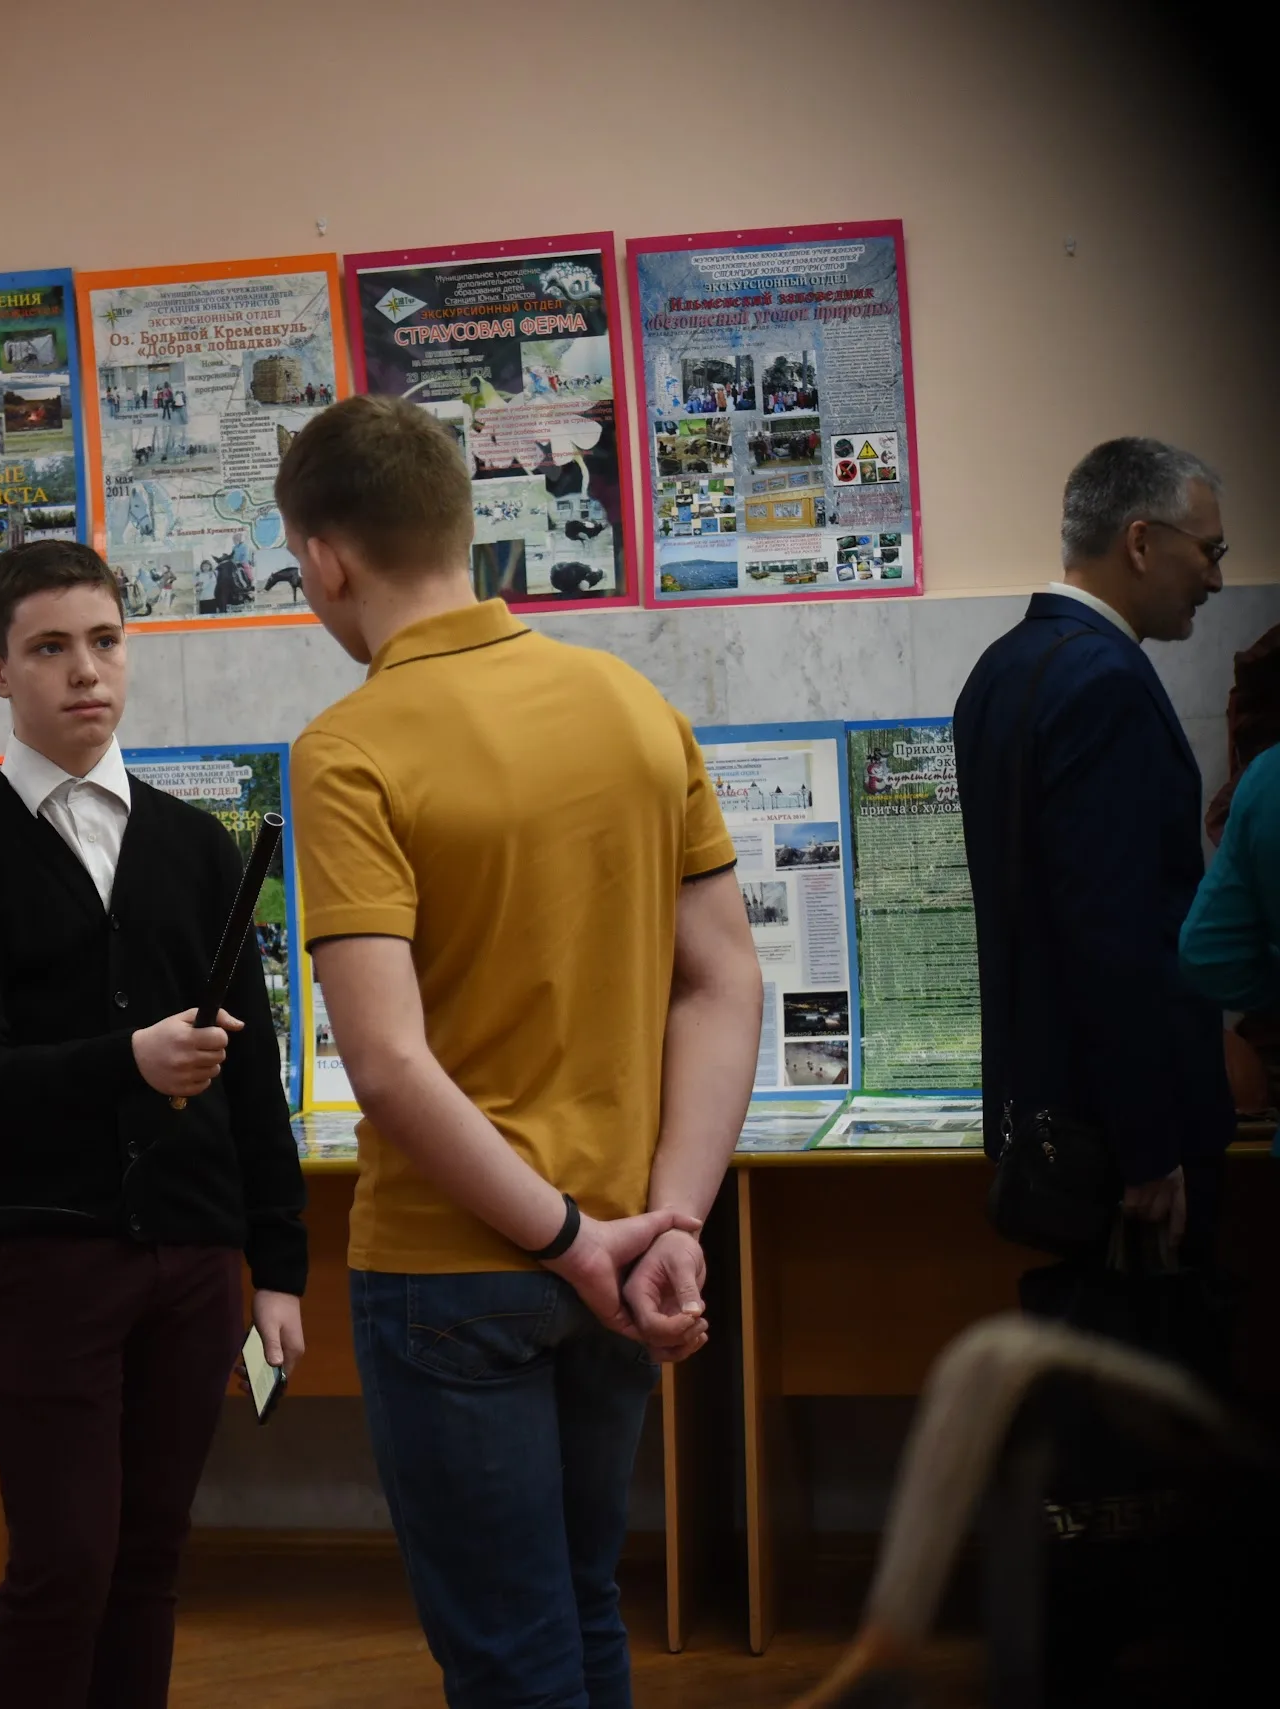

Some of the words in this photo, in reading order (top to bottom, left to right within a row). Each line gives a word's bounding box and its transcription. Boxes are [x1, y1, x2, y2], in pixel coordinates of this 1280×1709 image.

[435, 272, 494, 283] Муниципальное
[496, 268, 540, 280] учреждение
[713, 267, 759, 278] СТАНЦИЯ
[454, 286, 501, 297] образования
[503, 282, 525, 293] детей
[456, 277, 522, 289] дополнительного
[704, 275, 808, 293] ЭКСКУРСИОННЫЙ
[809, 273, 849, 288] ОТДЕЛ
[144, 297, 215, 308] ДОПОЛНИТЕЛЬНОГО
[216, 293, 269, 304] ОБРАЗОВАНИЯ
[270, 290, 294, 300] ДЕТЕЙ
[160, 288, 225, 299] МУНИЦИПАЛЬНОЕ
[227, 284, 274, 295] УЧРЕЖДЕНИЕ
[444, 296, 476, 306] Станция
[477, 293, 500, 304] Юных
[502, 290, 536, 302] Туристов
[157, 304, 200, 315] СТАНЦИЯ
[203, 301, 231, 312] ЮНЫХ
[234, 298, 280, 310] ТУРИСТОВ
[421, 302, 520, 321] ЭКСКУРСИОННЫЙ
[523, 298, 564, 313] ОТДЕЛ
[148, 312, 244, 328] ЭКСКУРСИОННЫЙ
[246, 309, 281, 323] ОТДЕЛ
[109, 333, 134, 347] Оз.
[140, 324, 208, 347] Большой
[213, 320, 308, 340] Кременкуль
[394, 318, 516, 347] СТРАУСОВАЯ
[519, 312, 588, 337] ФЕРМА
[137, 342, 203, 359] «Добрая
[207, 337, 282, 352] лошадка»
[105, 475, 111, 485] 8
[114, 475, 133, 485] мая
[106, 486, 130, 498] 2011
[171, 771, 225, 780] ОБРАЗОВАНИЯ
[226, 768, 250, 777] ДЕТЕЙ
[182, 763, 230, 772] УЧРЕЖДЕНИЕ
[156, 778, 186, 786] ЮНЫХ
[188, 776, 236, 785] ТУРИСТОВ
[203, 786, 239, 796] ОТДЕЛ
[860, 804, 906, 817] притча
[922, 800, 962, 816] худож
[766, 814, 792, 822] МАРТА
